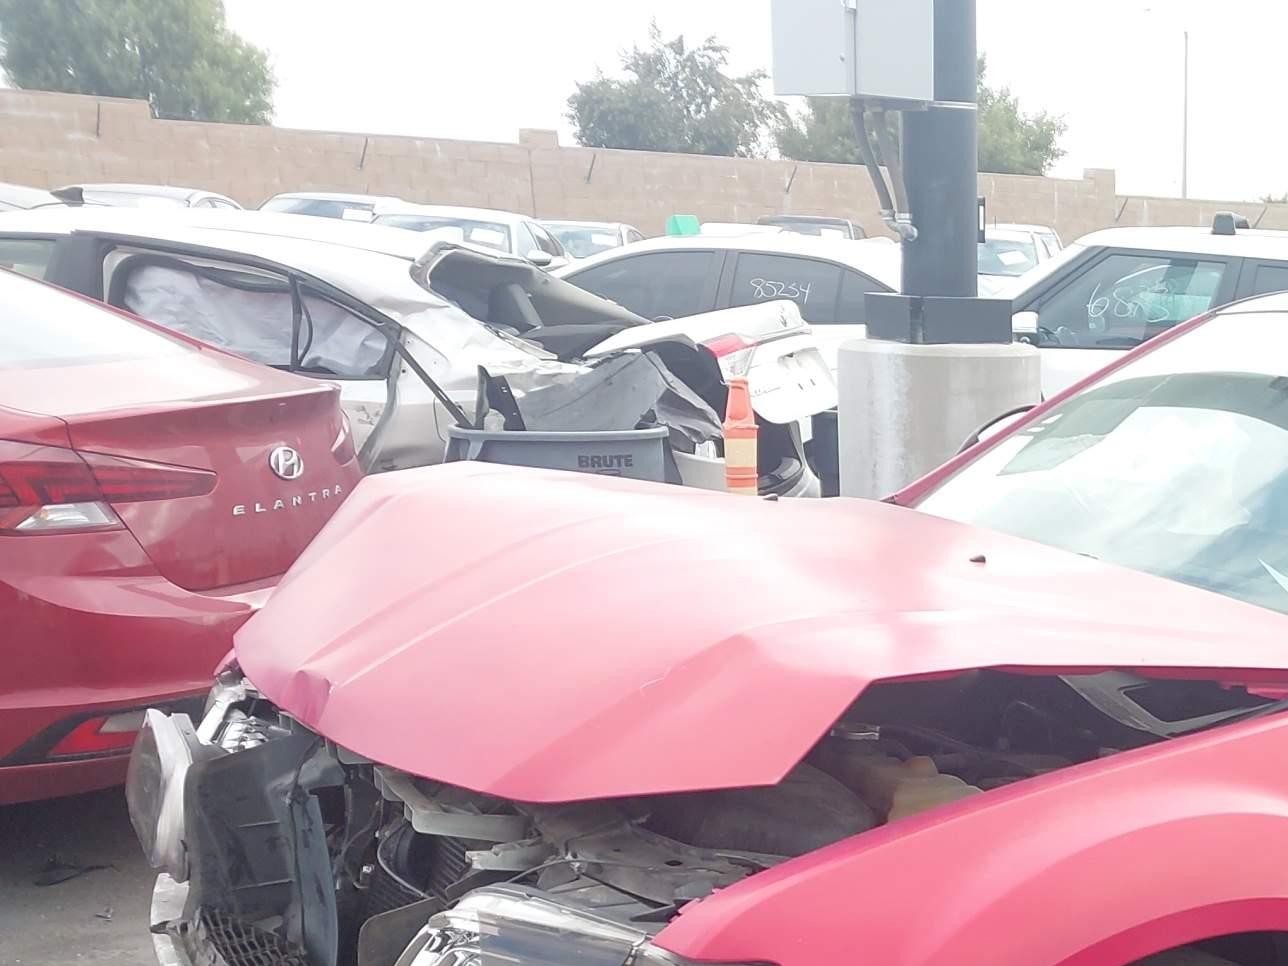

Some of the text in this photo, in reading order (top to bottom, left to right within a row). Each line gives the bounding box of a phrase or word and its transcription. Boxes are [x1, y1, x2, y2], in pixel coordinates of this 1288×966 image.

[750, 278, 811, 304] 85254
[577, 453, 633, 468] BRUTE
[232, 484, 342, 515] ELANTRA
